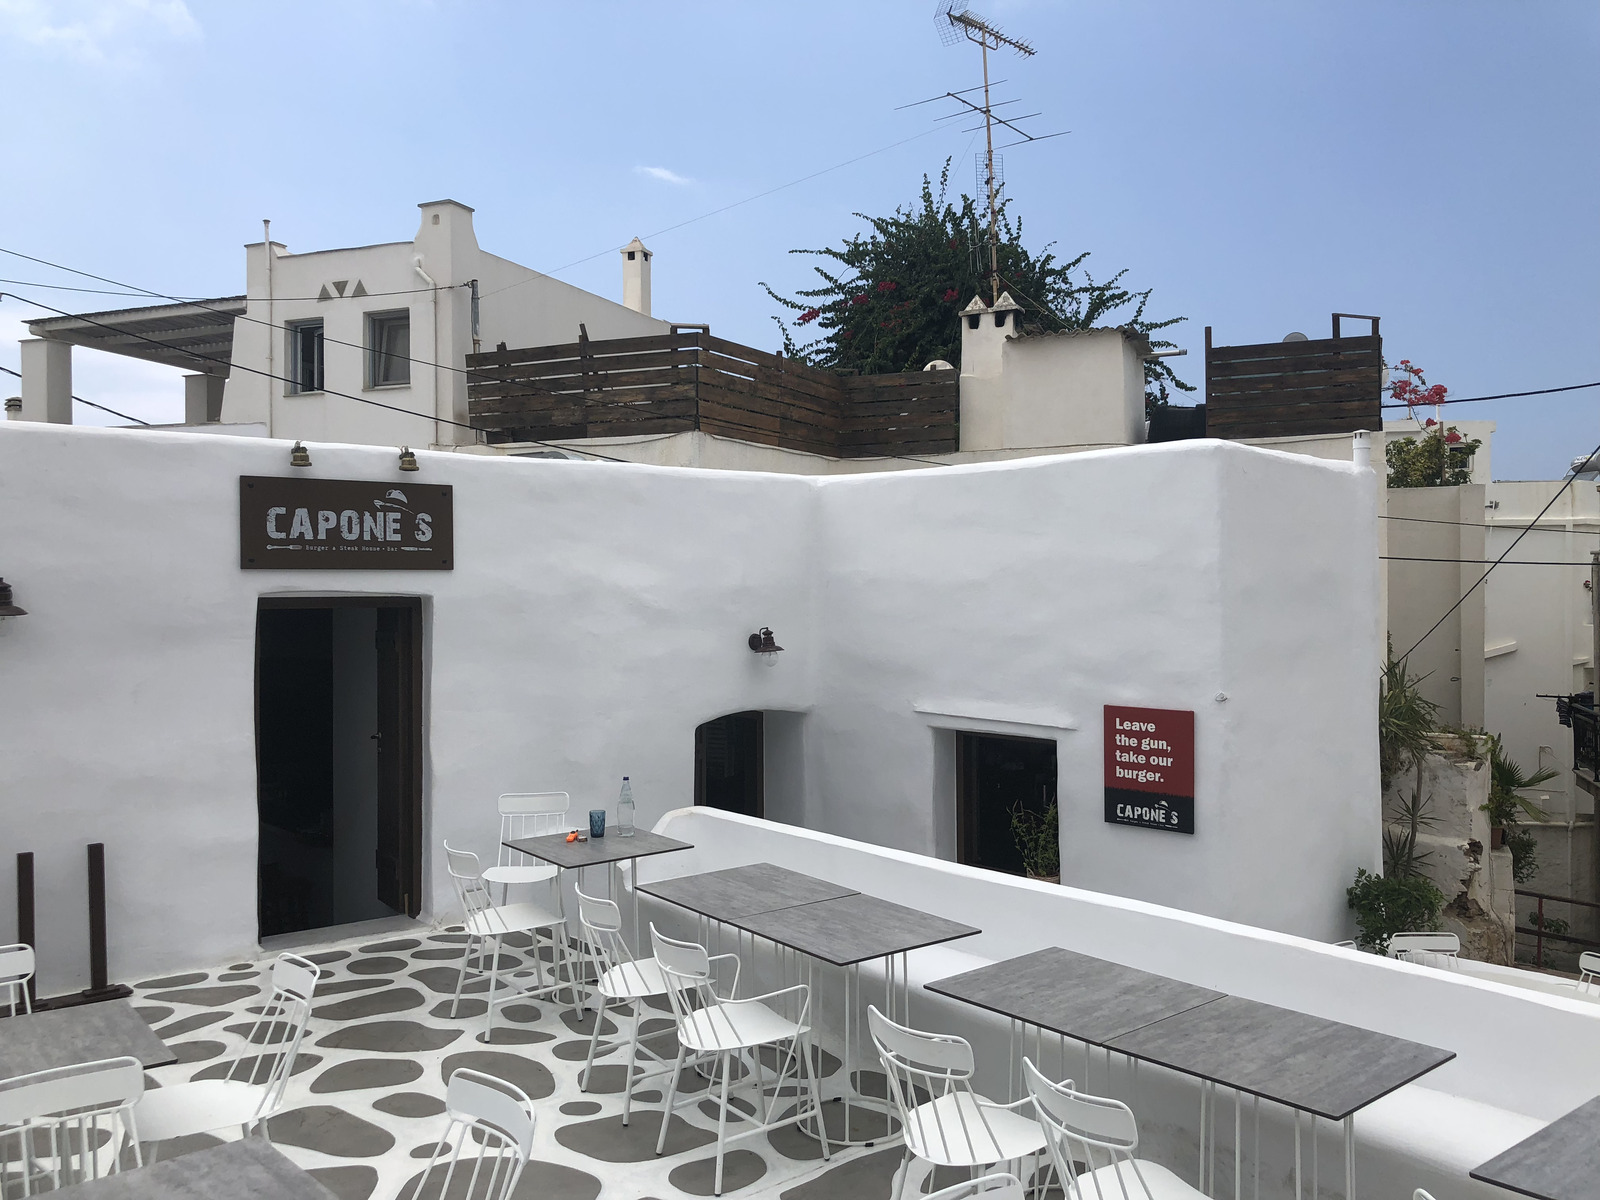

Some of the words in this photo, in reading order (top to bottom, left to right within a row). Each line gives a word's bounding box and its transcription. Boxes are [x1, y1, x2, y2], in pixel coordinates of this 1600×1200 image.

[1115, 717, 1156, 732] Leave
[1115, 733, 1138, 747] the
[1140, 737, 1172, 752] gun,
[1115, 749, 1146, 764] take
[1149, 755, 1174, 767] our
[1115, 765, 1164, 783] burger.
